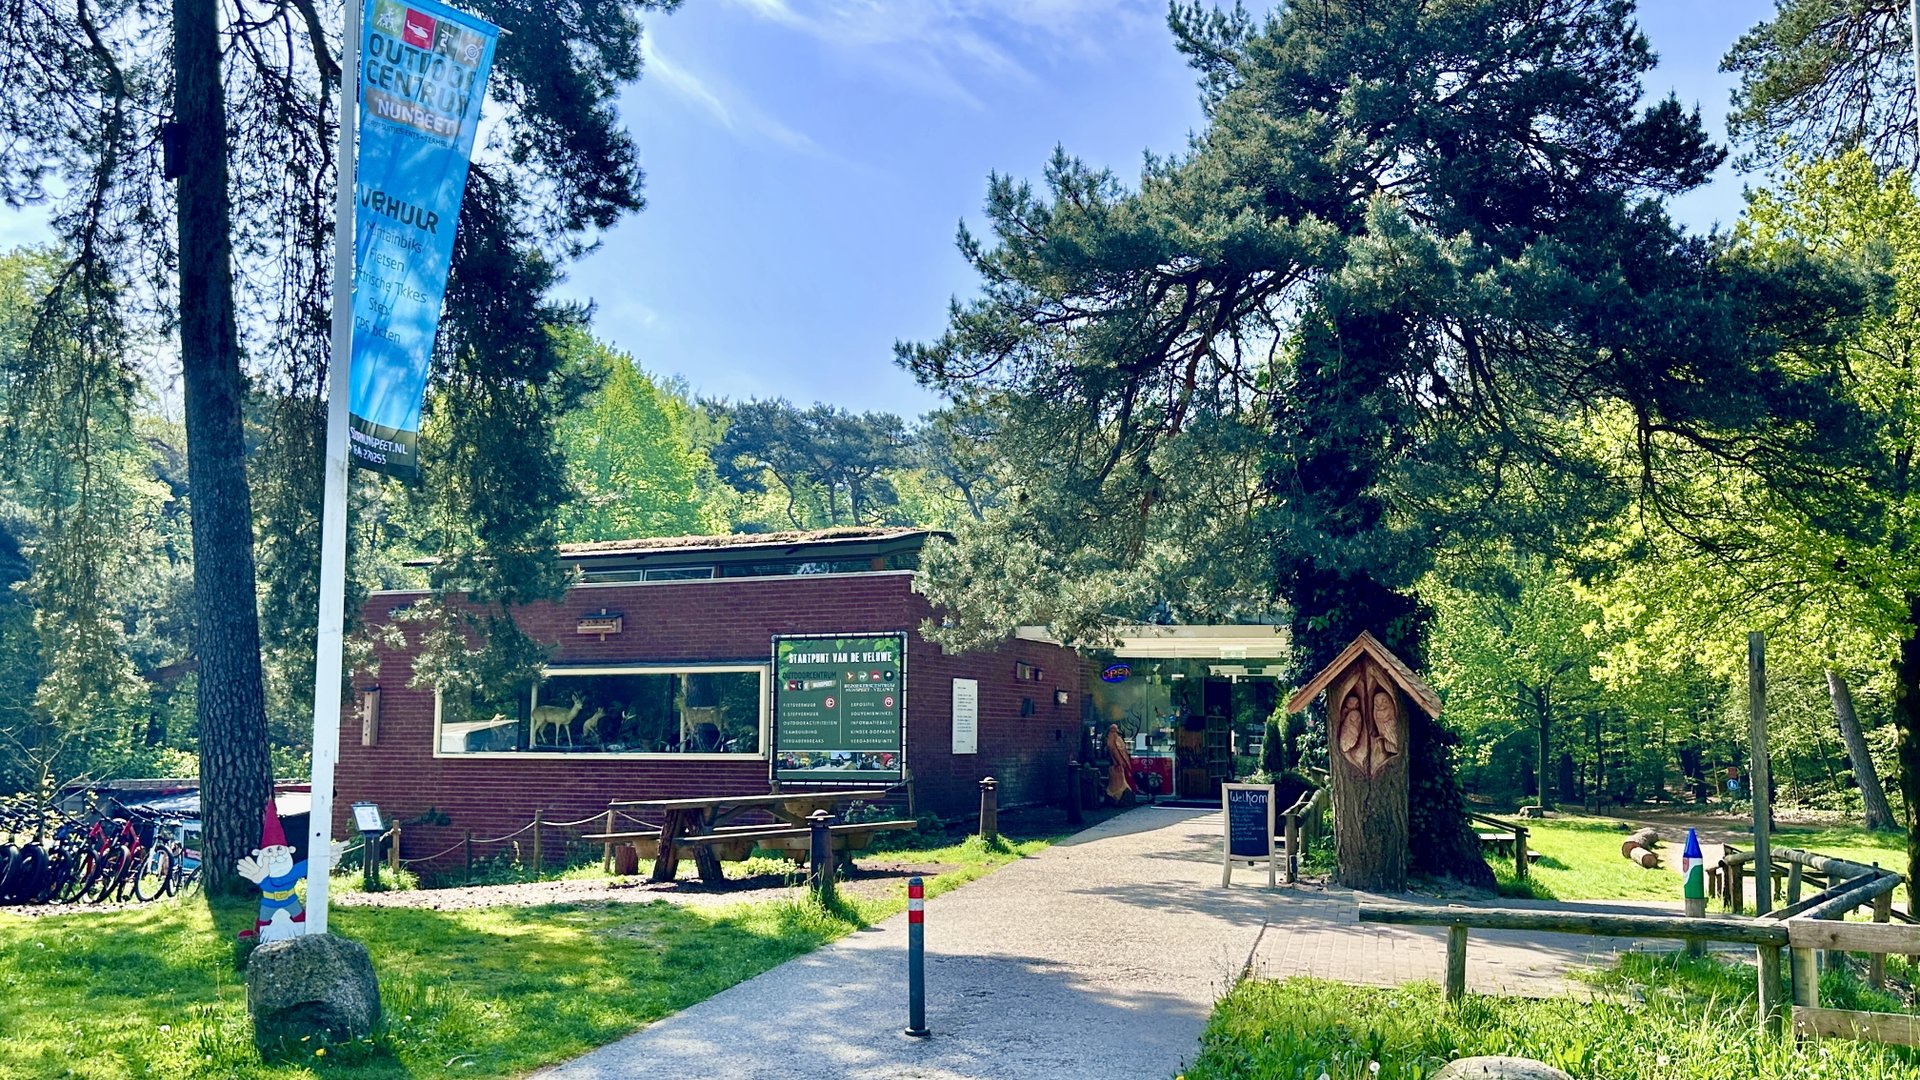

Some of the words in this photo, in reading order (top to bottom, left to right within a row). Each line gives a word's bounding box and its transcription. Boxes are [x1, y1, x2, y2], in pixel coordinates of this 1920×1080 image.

[370, 247, 404, 272] Fietsen
[788, 652, 830, 664] STARTPUNT
[832, 651, 850, 663] VAN
[850, 651, 860, 663] DE
[862, 651, 893, 663] VELUWE
[1102, 668, 1131, 680] OPEN
